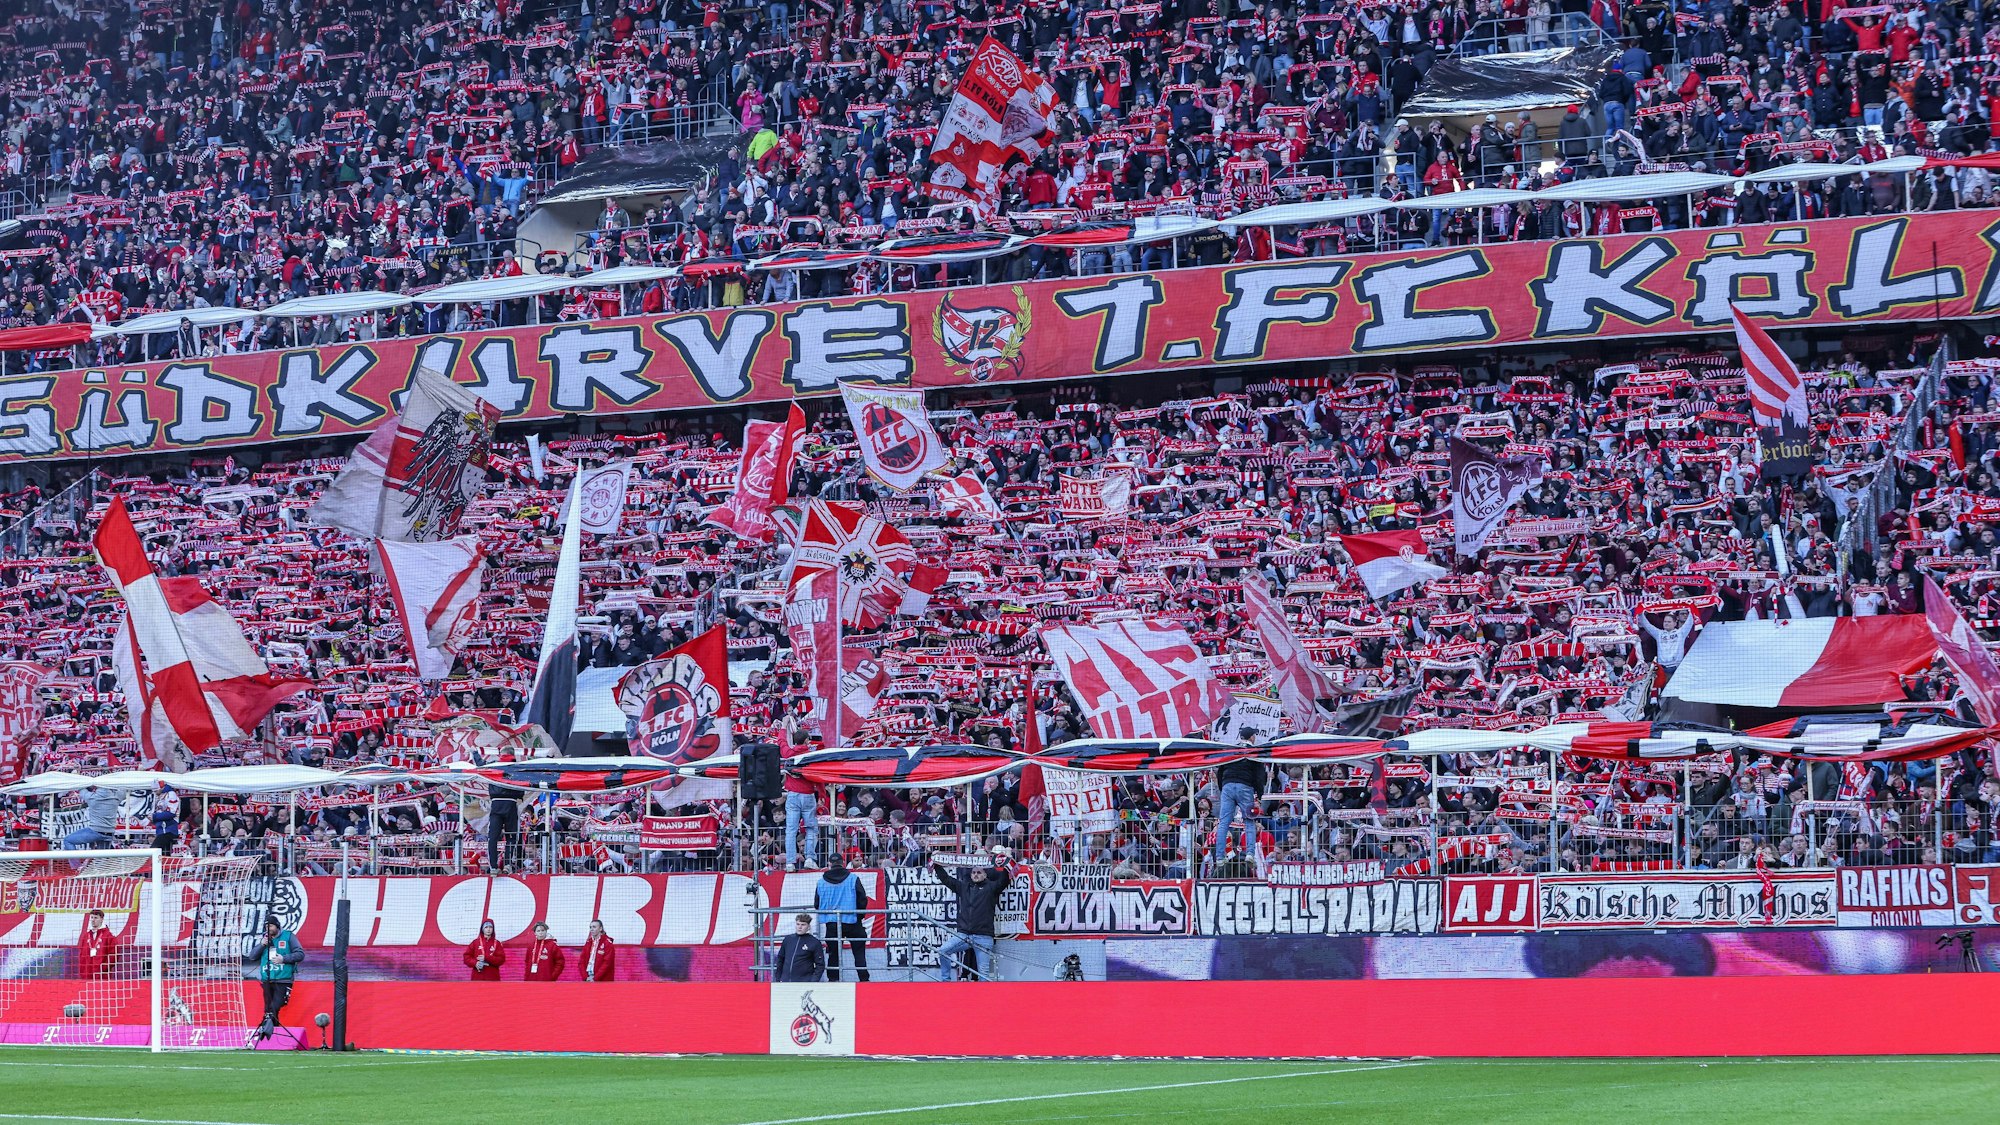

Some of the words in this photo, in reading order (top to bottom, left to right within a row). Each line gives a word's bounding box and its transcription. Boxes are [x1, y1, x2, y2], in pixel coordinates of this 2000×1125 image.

[1527, 216, 2000, 338] KÖL
[968, 319, 1001, 351] 12
[1638, 386, 1658, 394] KÖLN
[1857, 434, 1877, 442] KÖLN
[1061, 481, 1100, 495] ROTE
[1061, 497, 1102, 510] WAND
[1477, 497, 1505, 517] KÖLN
[1676, 577, 1704, 585] KÖLN
[726, 639, 741, 648] SPS
[742, 638, 758, 647] CGN
[760, 637, 769, 645] 51
[943, 656, 966, 664] KÖLN
[1411, 649, 1432, 657] KÖLN
[912, 682, 936, 690] KÖLN
[1570, 680, 1600, 688] KÖLN
[730, 709, 740, 717] FC
[741, 703, 764, 715] KÖLN
[1238, 701, 1273, 717] Football
[648, 705, 685, 732] 1.FC
[651, 729, 681, 748] KÖLN
[1088, 775, 1110, 787] BIST
[1458, 777, 1475, 785] AJJ
[1050, 786, 1113, 817] FREI
[652, 821, 682, 831] JEMAND
[684, 820, 701, 830] SEIN
[1061, 864, 1112, 876] DIFFIDATI
[35, 877, 140, 910] STADIONVERBOT
[1841, 867, 1948, 907] RAFIKIS
[1038, 887, 1185, 933] COLONIACS
[1197, 879, 1438, 934] VEEDELSRADAU
[1452, 883, 1530, 924] AJJ
[1541, 885, 1680, 926] Kölsche
[1691, 882, 1831, 928] Mythos
[1871, 909, 1922, 927] COLONIA
